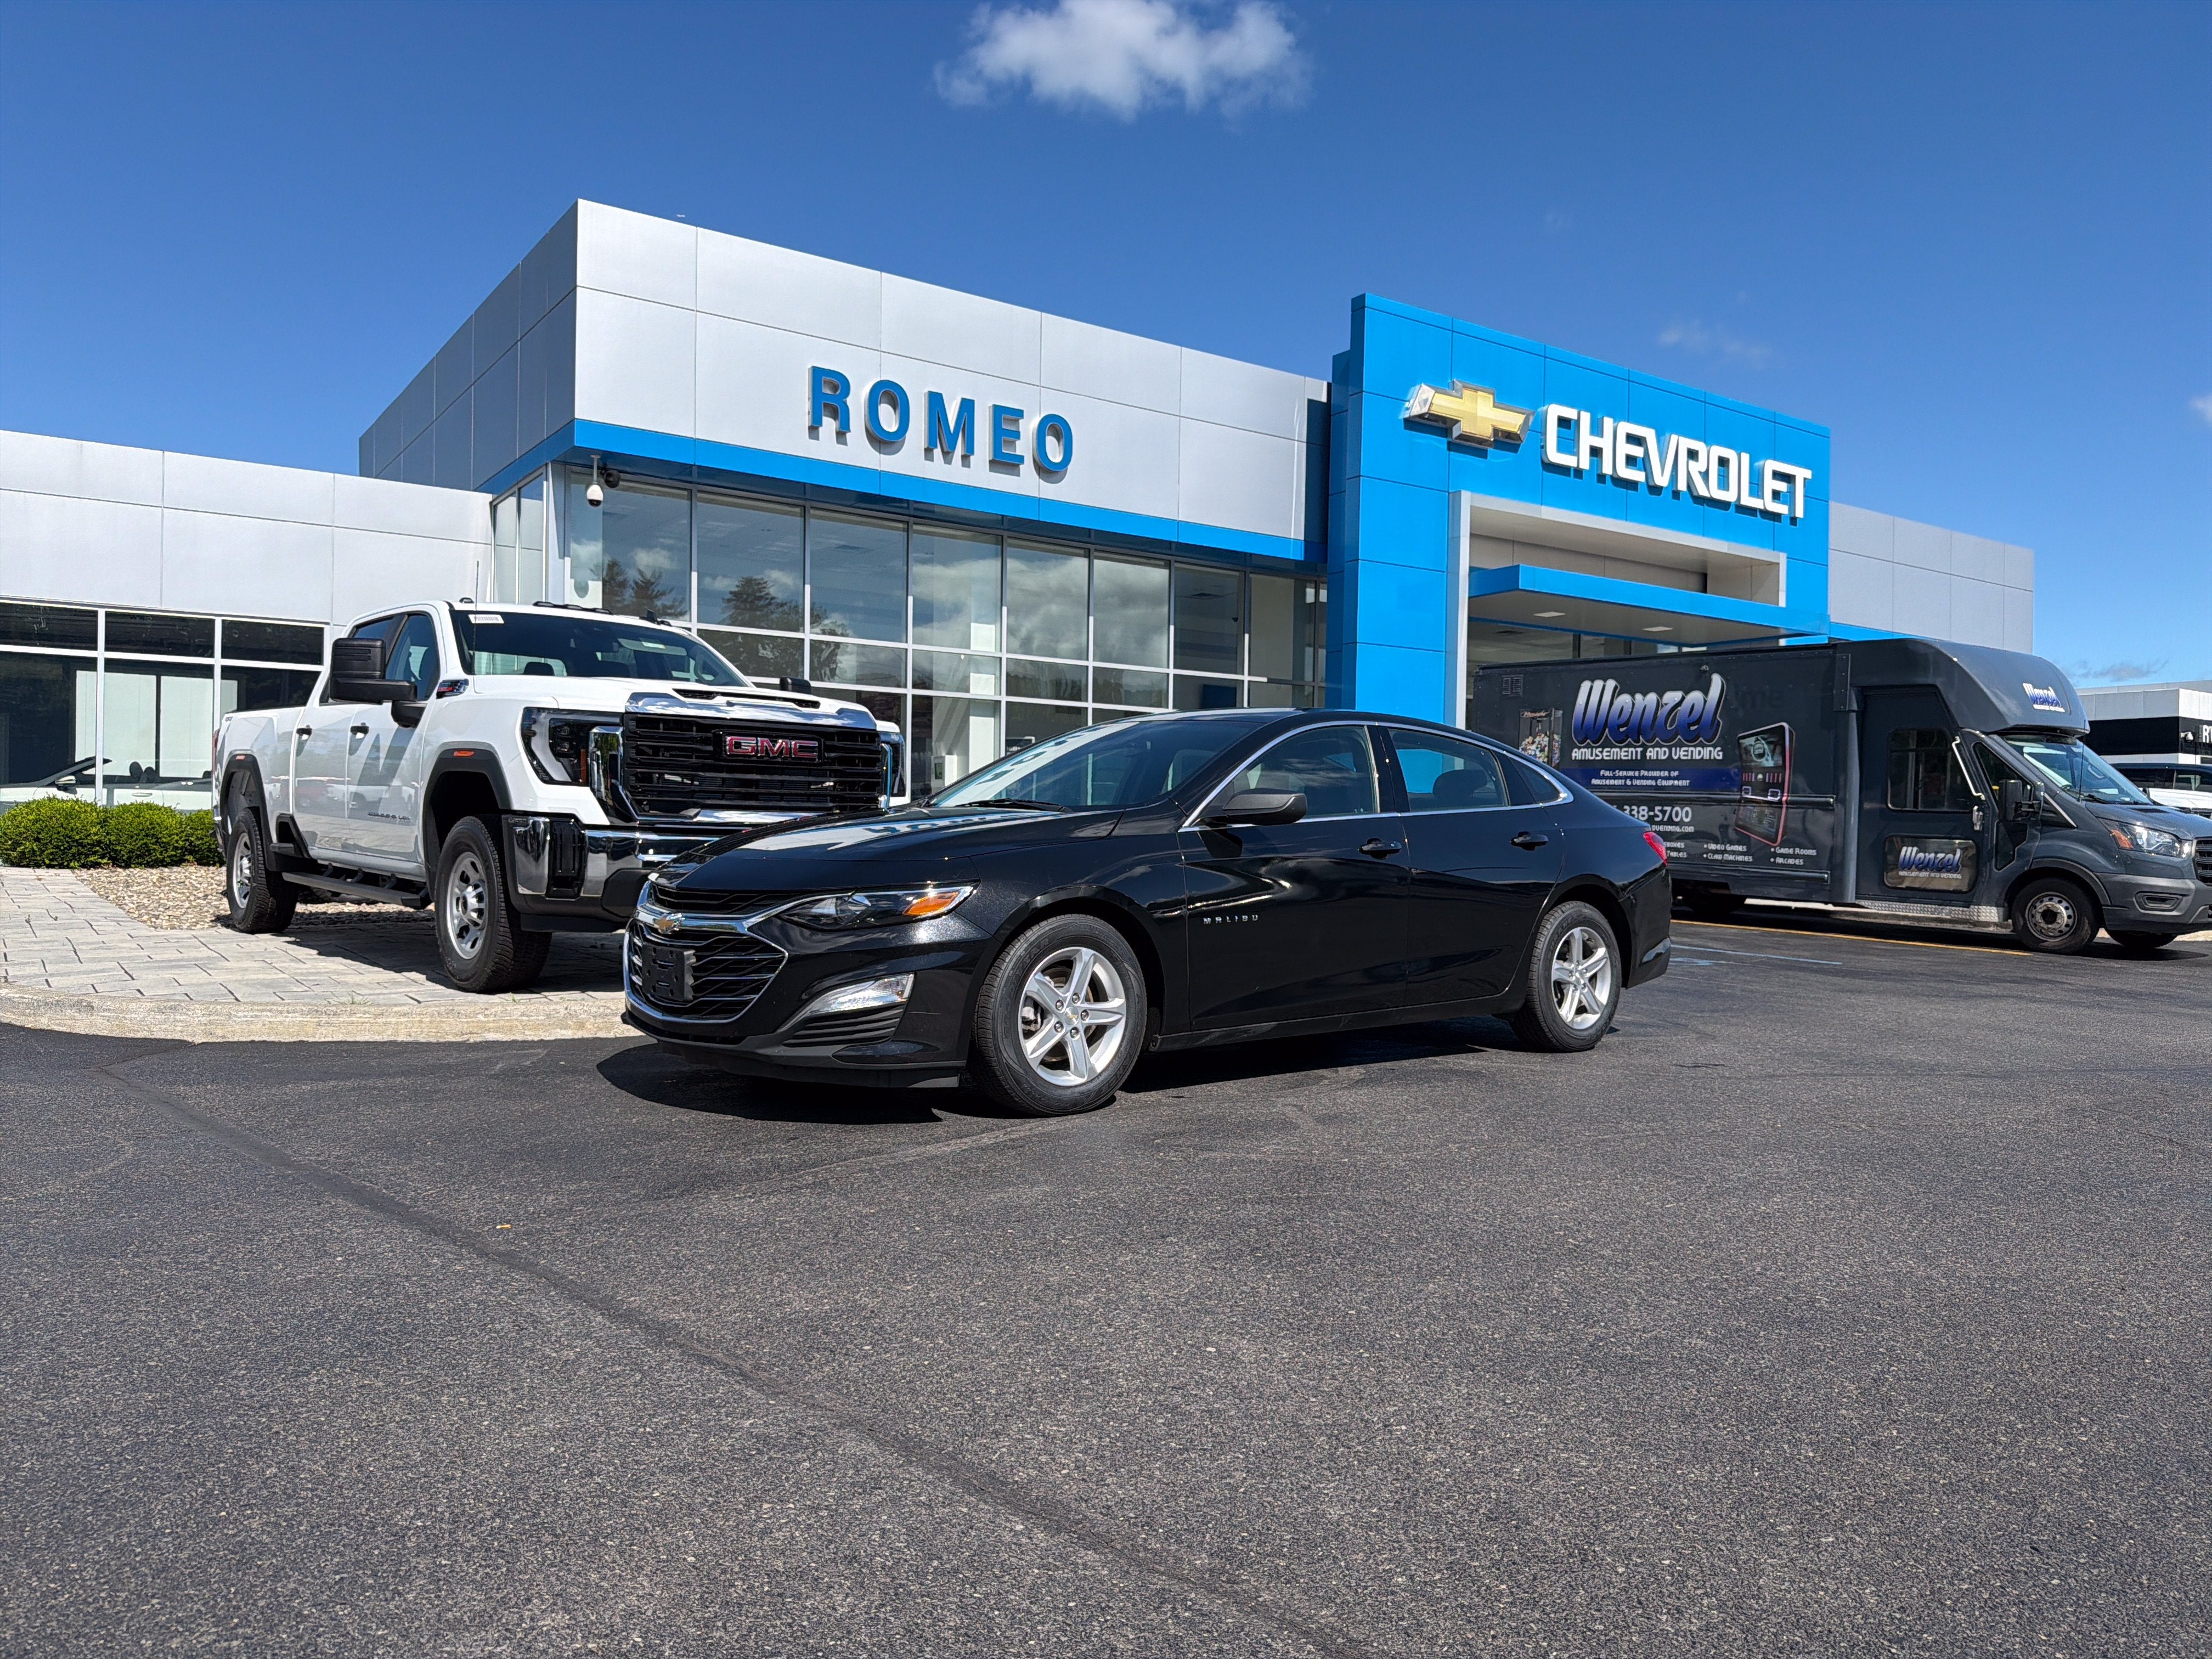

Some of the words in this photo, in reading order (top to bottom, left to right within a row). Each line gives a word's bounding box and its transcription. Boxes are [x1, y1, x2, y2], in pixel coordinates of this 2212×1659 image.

[808, 366, 1073, 471] ROMEO
[1544, 404, 1812, 518] CHEVROLET
[1572, 673, 1726, 746] Wenzel
[725, 736, 818, 758] GMC
[1572, 748, 1643, 760] AMUSEMENT
[1646, 747, 1669, 760] AND
[1672, 747, 1723, 760] VENDING
[1899, 846, 1962, 873] Wenzel
[1203, 915, 1259, 924] MALIBU
